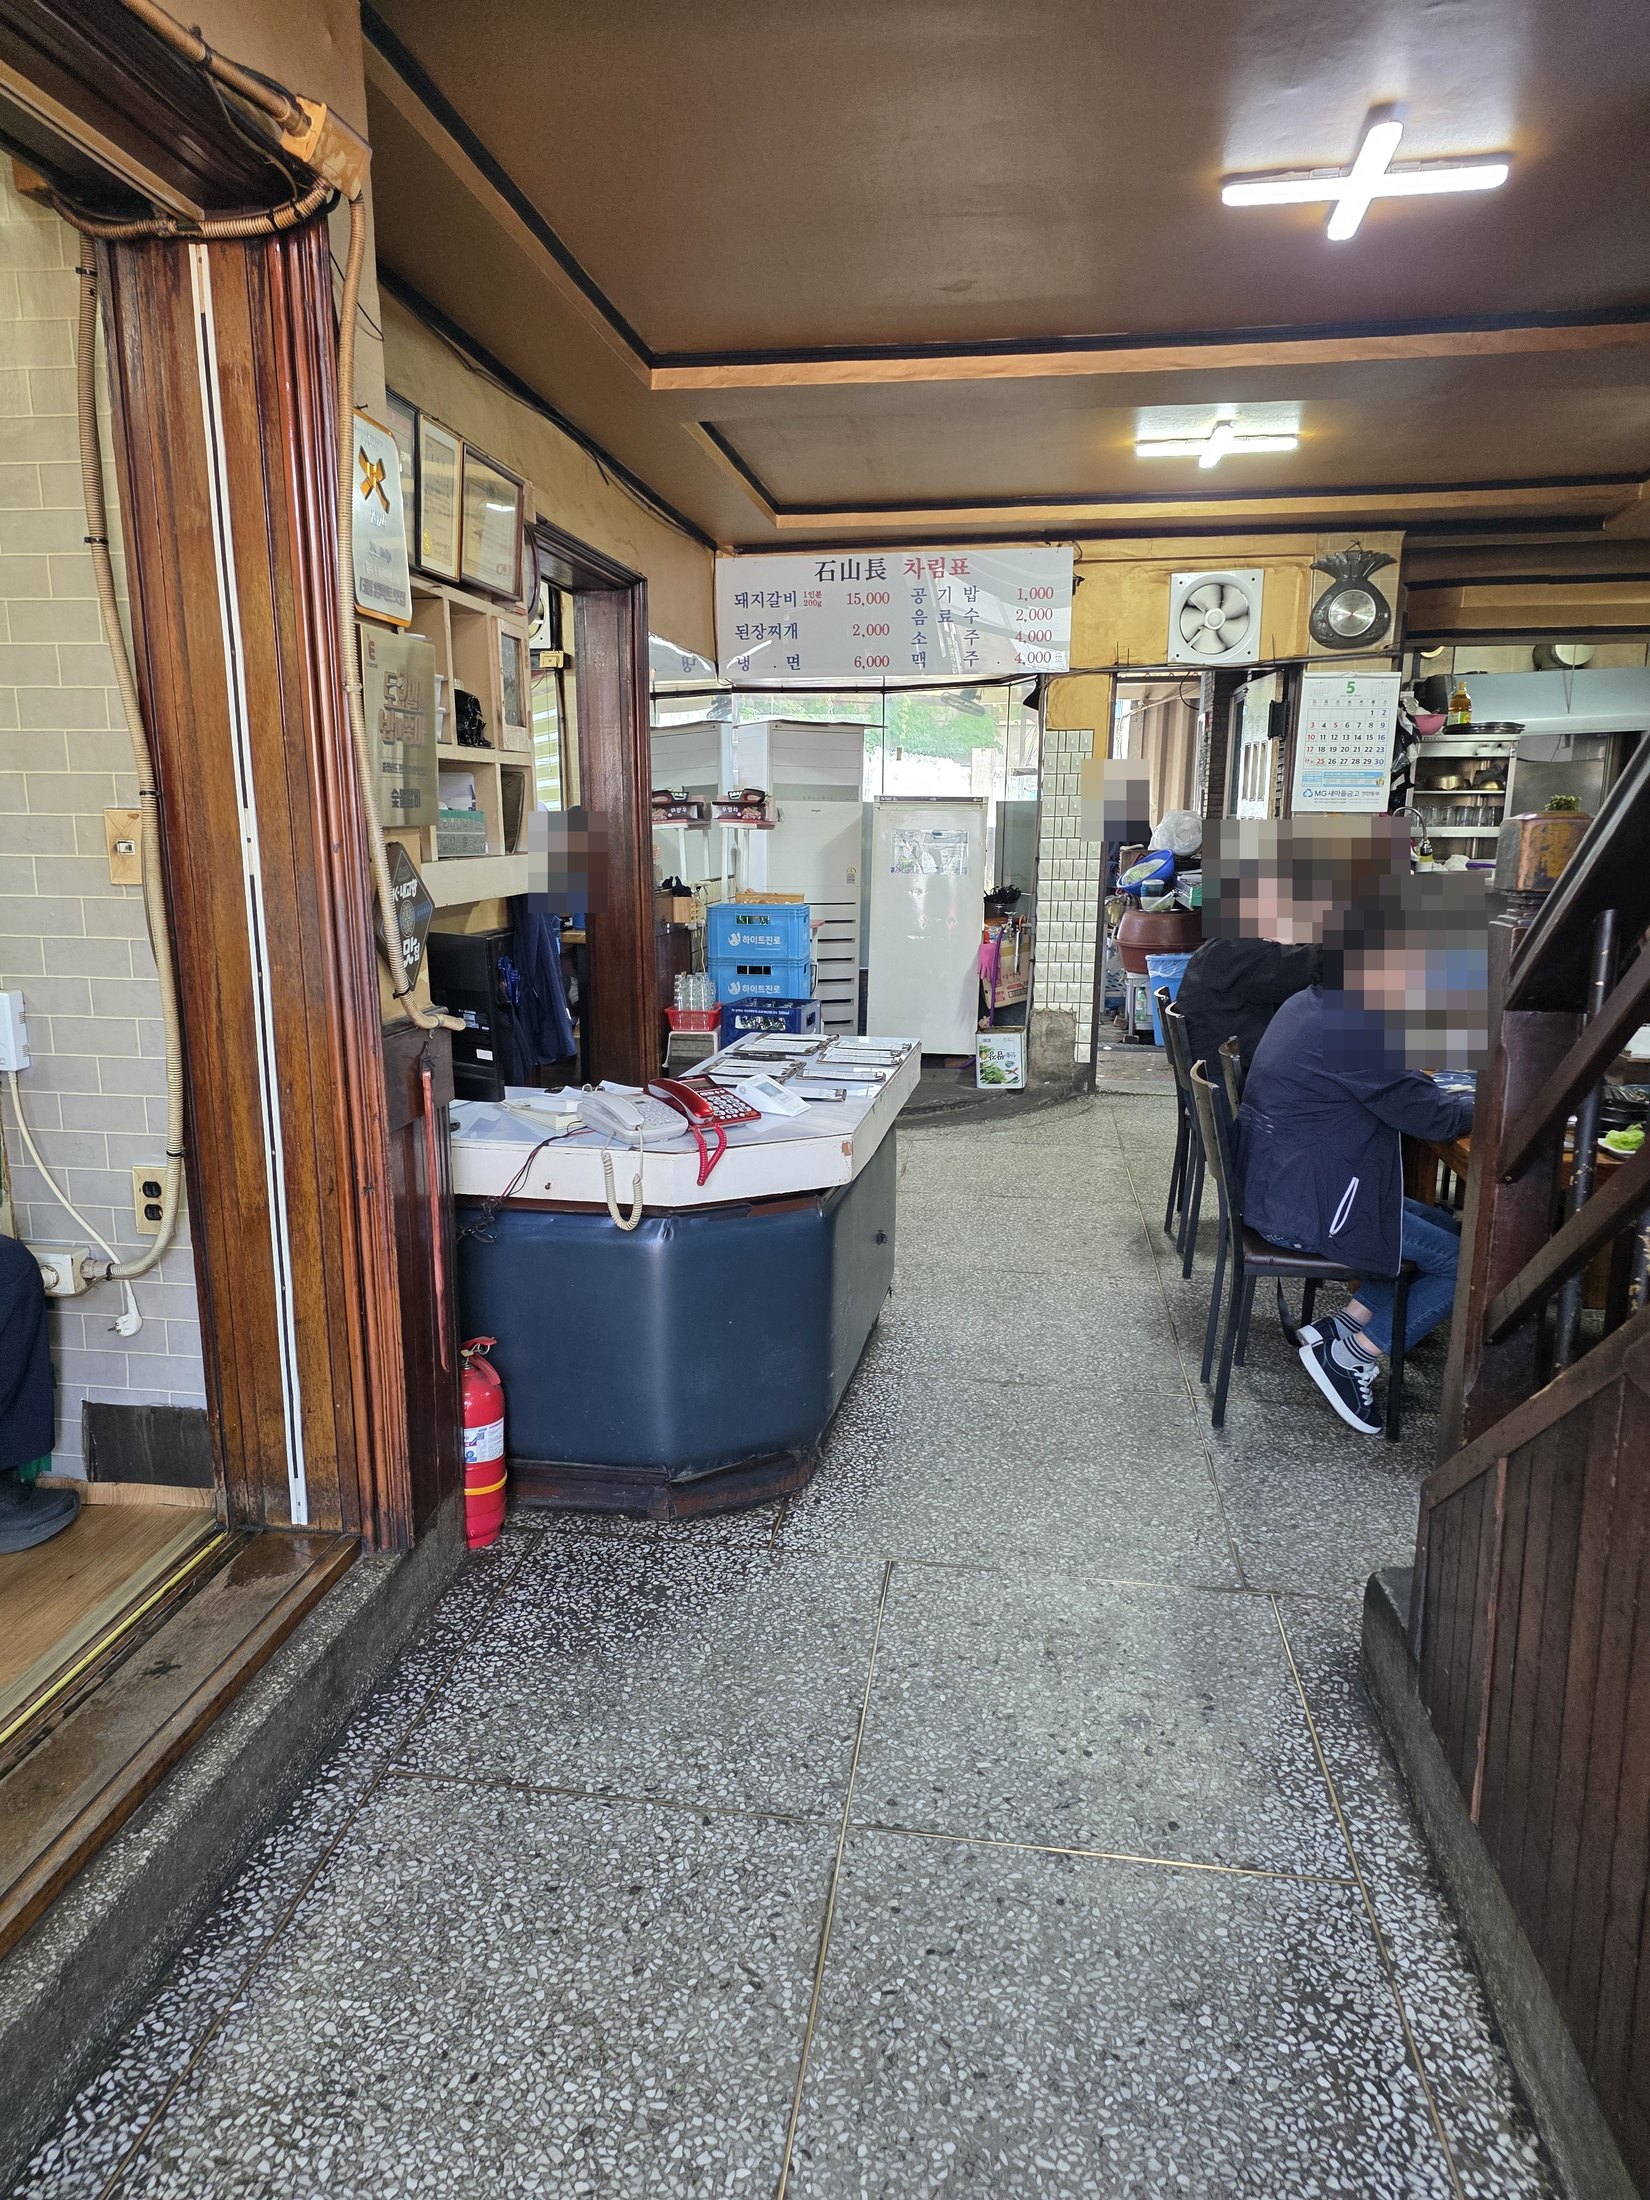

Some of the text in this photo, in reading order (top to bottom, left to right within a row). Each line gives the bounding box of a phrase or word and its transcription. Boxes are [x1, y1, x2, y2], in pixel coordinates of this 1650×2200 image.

[814, 557, 971, 582] 石山長 차림표
[734, 591, 890, 608] 돼지갈비 15,000
[803, 590, 823, 599] 1인분
[1017, 587, 1054, 601] 1,000
[803, 599, 823, 608] 200g
[1016, 608, 1053, 623] 2,000
[735, 622, 890, 640] 된장찌개 2,000
[1015, 630, 1052, 644] 4,000
[854, 655, 890, 669] 6,000
[1014, 651, 1051, 665] 4,000
[1346, 681, 1356, 694] 5
[742, 935, 781, 945] 하이트진로
[742, 984, 781, 994] 하이트진로
